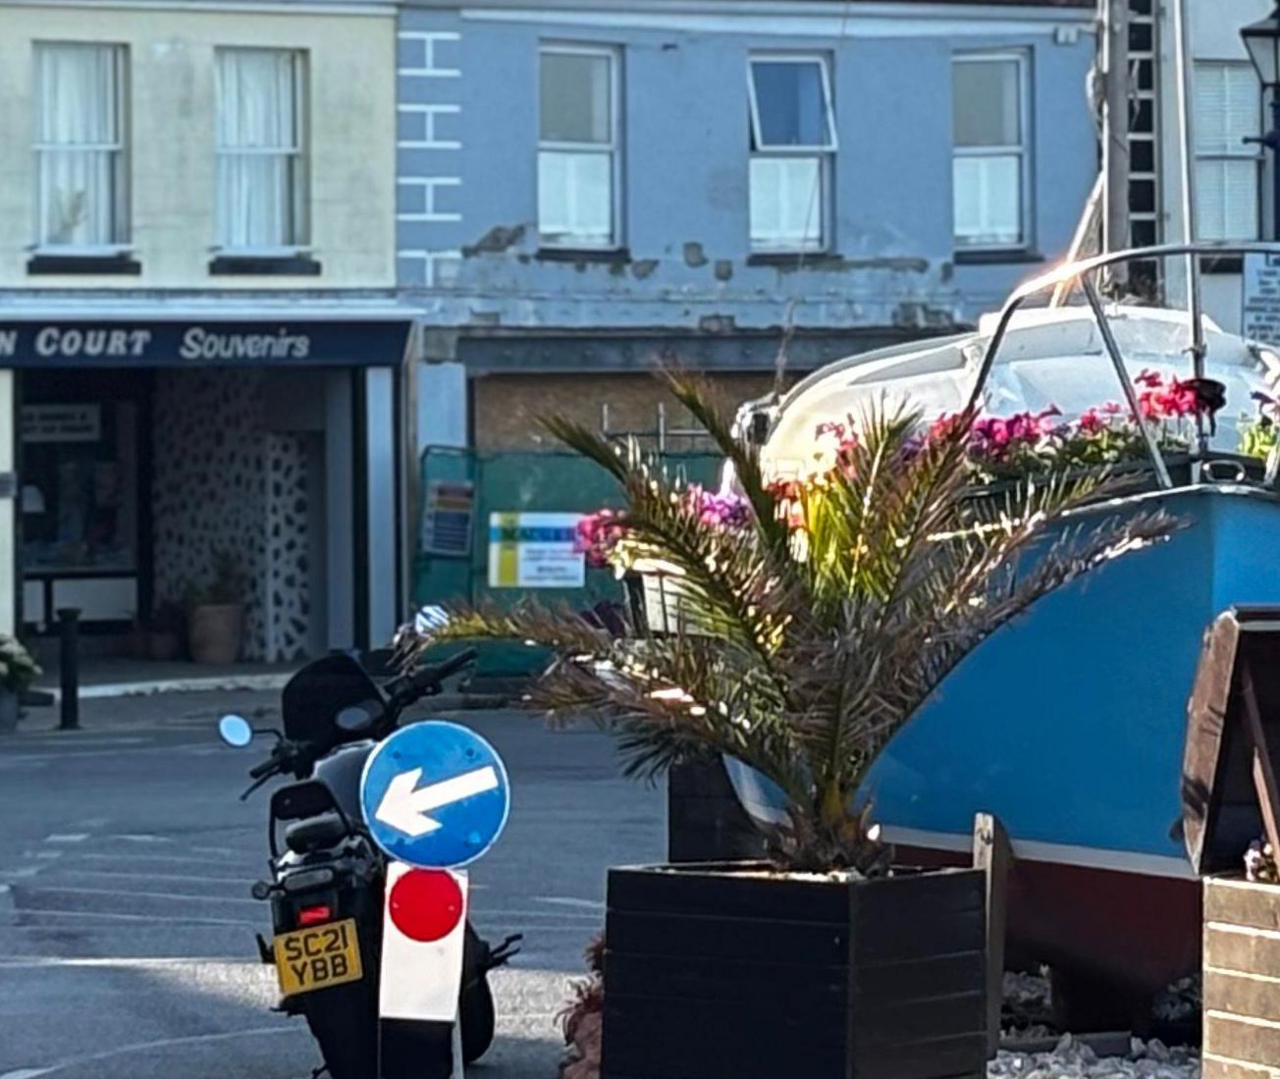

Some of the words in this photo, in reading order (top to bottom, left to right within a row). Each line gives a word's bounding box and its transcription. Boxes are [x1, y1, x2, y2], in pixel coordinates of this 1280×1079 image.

[35, 327, 151, 357] COURT
[179, 327, 310, 360] Souvenirs
[284, 924, 349, 962] SC21
[291, 953, 349, 986] YBB
